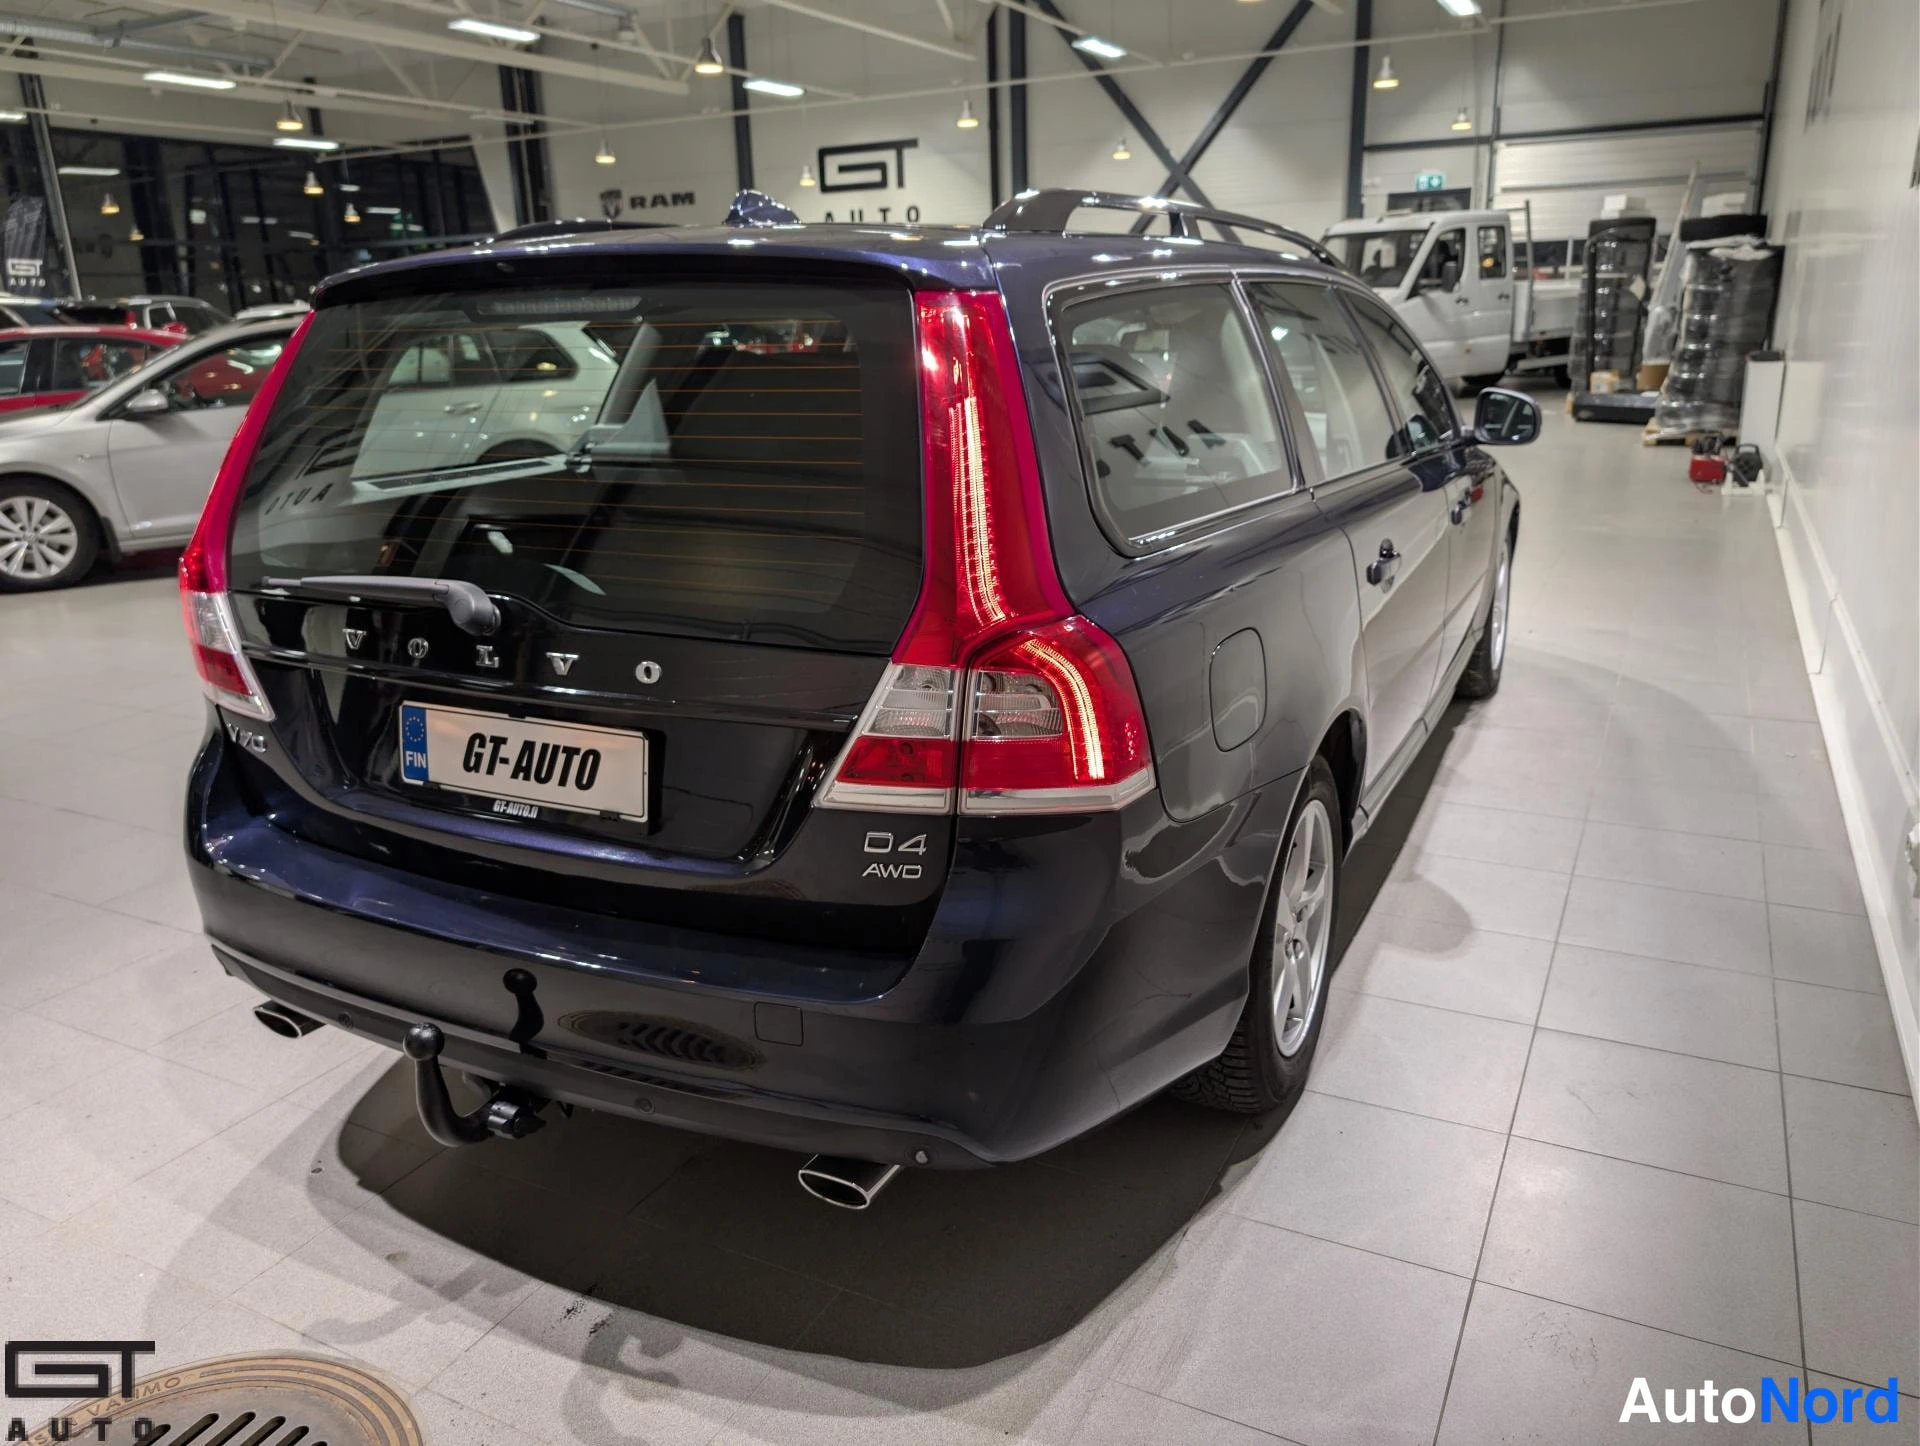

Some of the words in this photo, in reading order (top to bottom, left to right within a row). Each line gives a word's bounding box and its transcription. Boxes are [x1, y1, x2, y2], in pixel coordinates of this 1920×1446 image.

[818, 138, 919, 194] GT
[629, 192, 696, 210] RAM
[825, 205, 921, 223] AUTO
[8, 278, 46, 288] AUTO
[342, 628, 663, 685] VOLVO
[406, 750, 428, 769] FIN
[462, 732, 602, 791] GT-AUTO
[862, 831, 928, 856] D4
[861, 863, 923, 880] AWD
